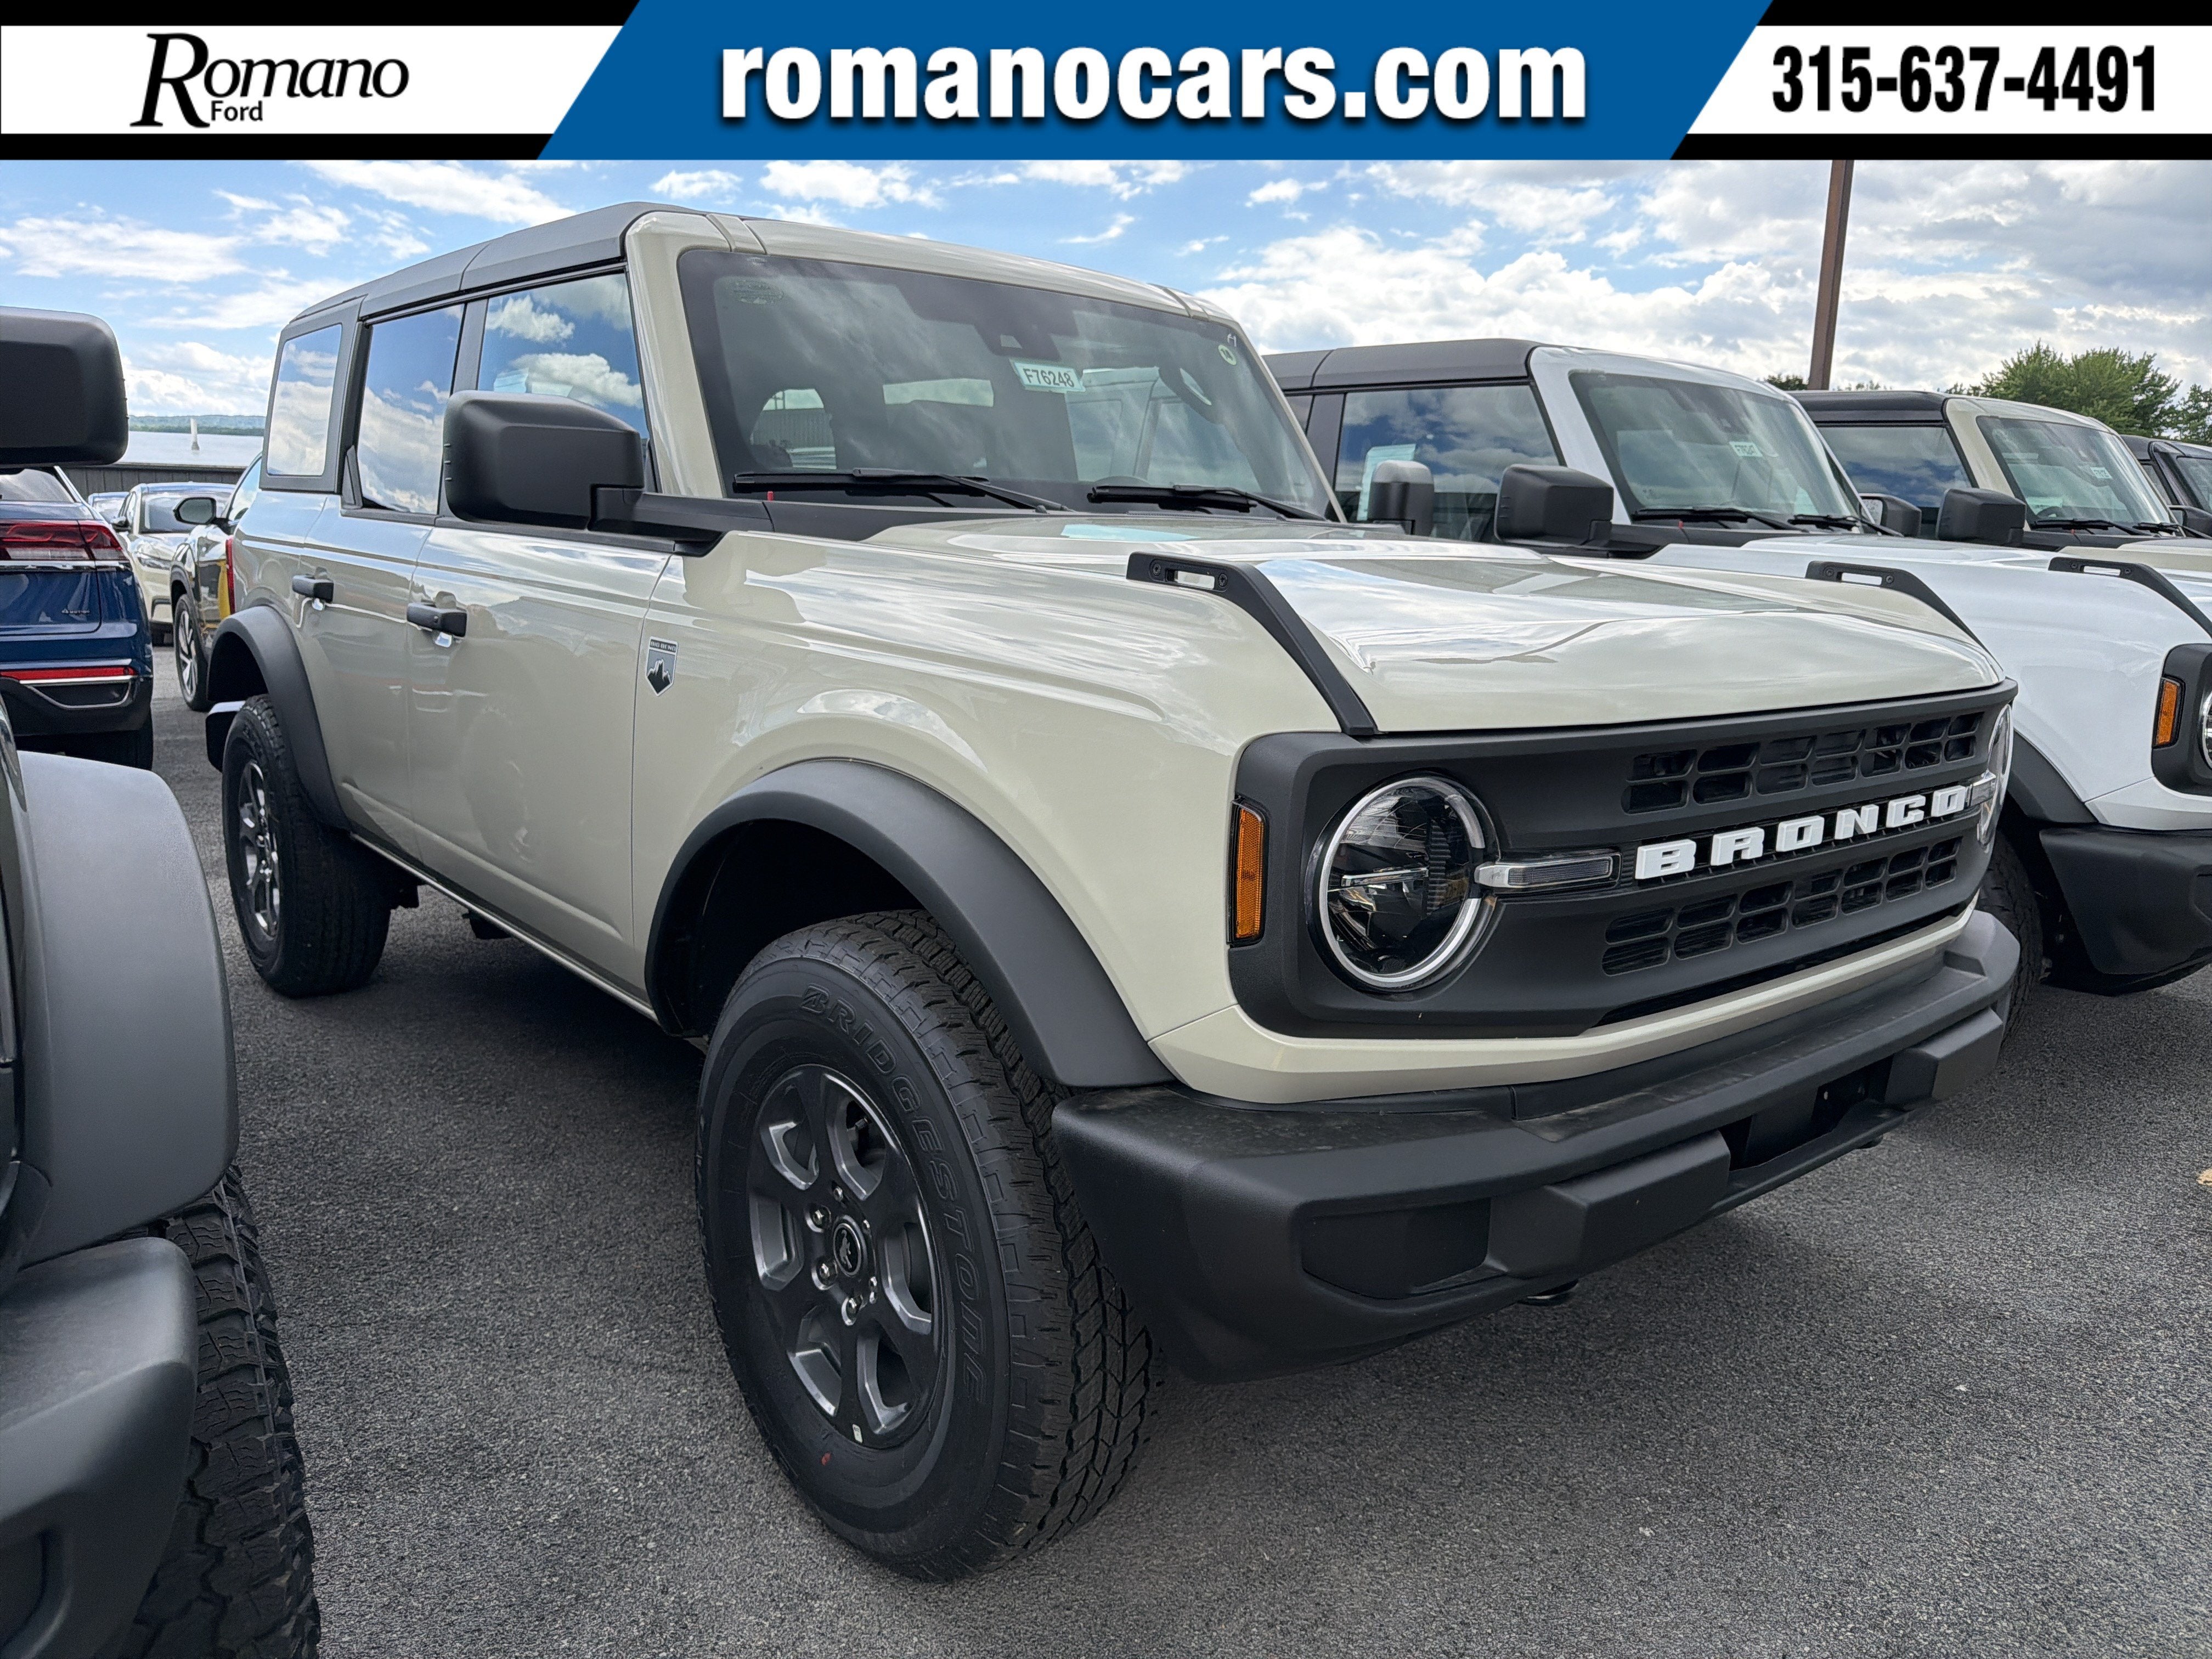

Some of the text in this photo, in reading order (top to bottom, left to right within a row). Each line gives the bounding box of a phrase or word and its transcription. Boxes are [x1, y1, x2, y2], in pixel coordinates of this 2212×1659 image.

[1023, 368, 1075, 388] F76248
[1635, 786, 1966, 880] BRONCO
[800, 983, 988, 1403] BRIDGESTONE
